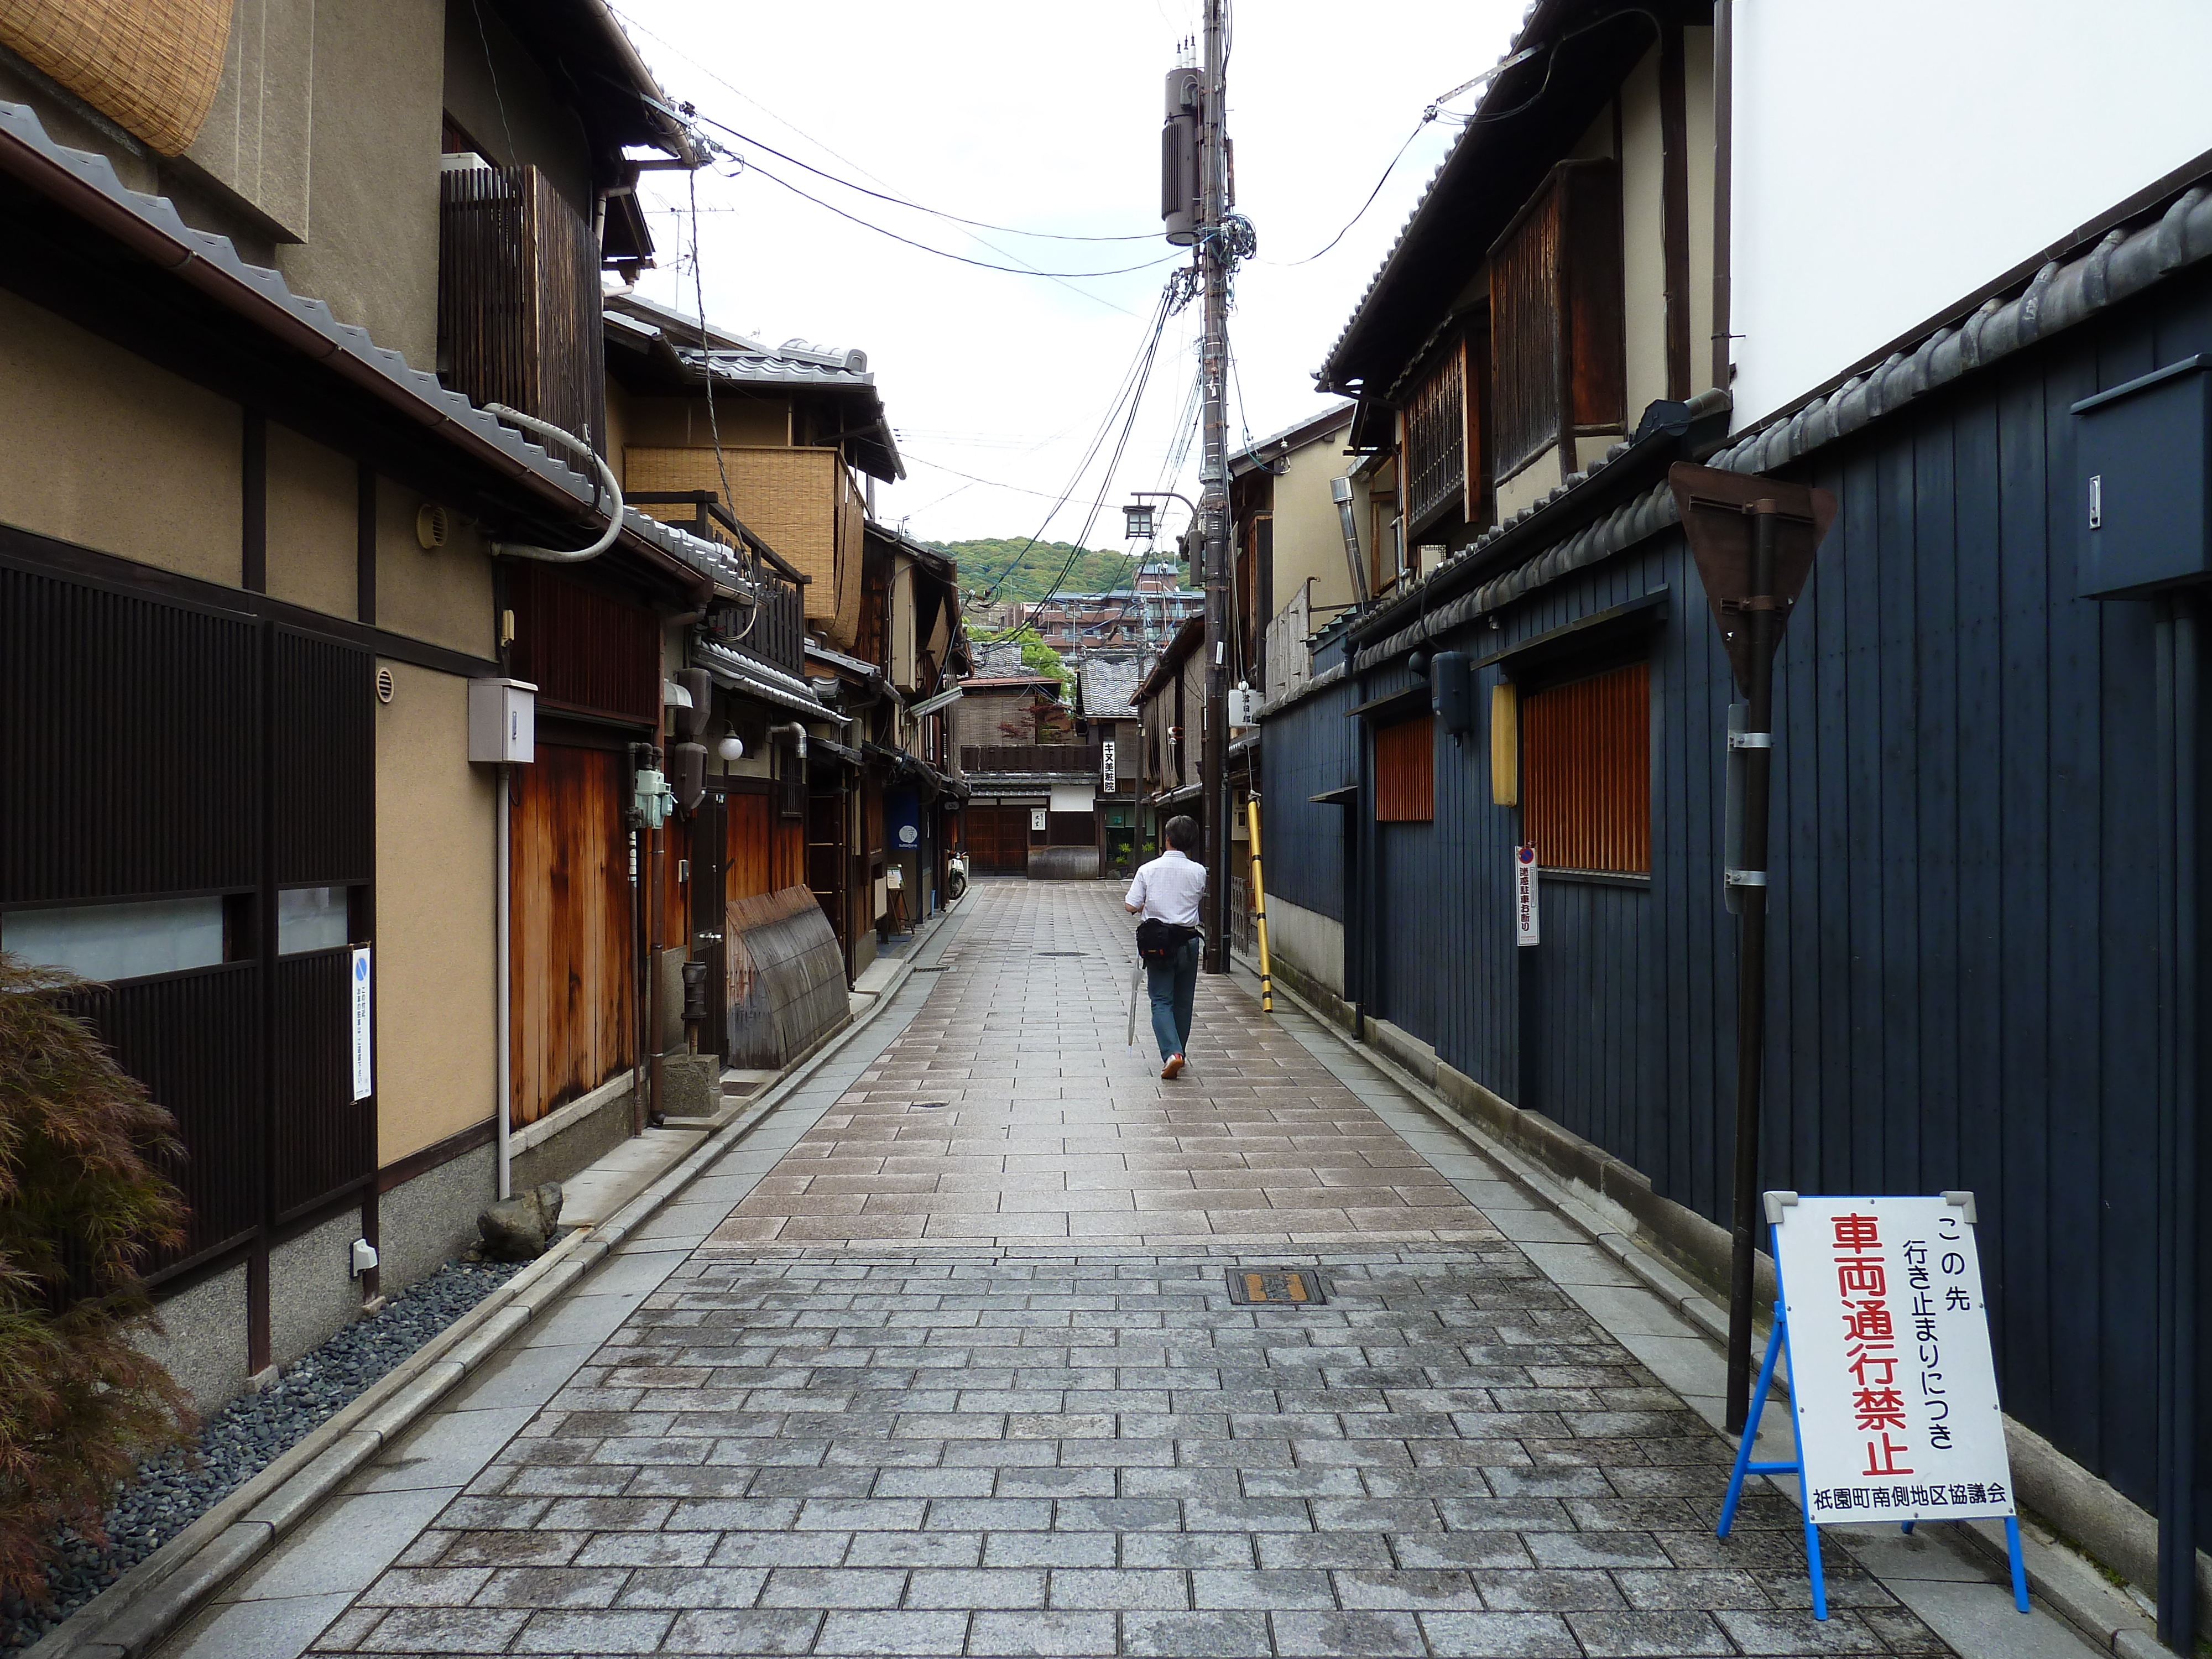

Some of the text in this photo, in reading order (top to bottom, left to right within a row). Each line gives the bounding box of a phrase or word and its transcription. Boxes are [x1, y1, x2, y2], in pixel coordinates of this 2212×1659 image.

[1104, 743, 1114, 791] キヌ美粧院
[1519, 867, 1530, 931] 迷惑駐車お断り
[1938, 1217, 1970, 1311] この先
[1830, 1213, 1914, 1477] 車両通行禁止
[1902, 1239, 1952, 1450] 行き止まりにつき
[1813, 1481, 2006, 1510] 祇園町南側地区協議会
